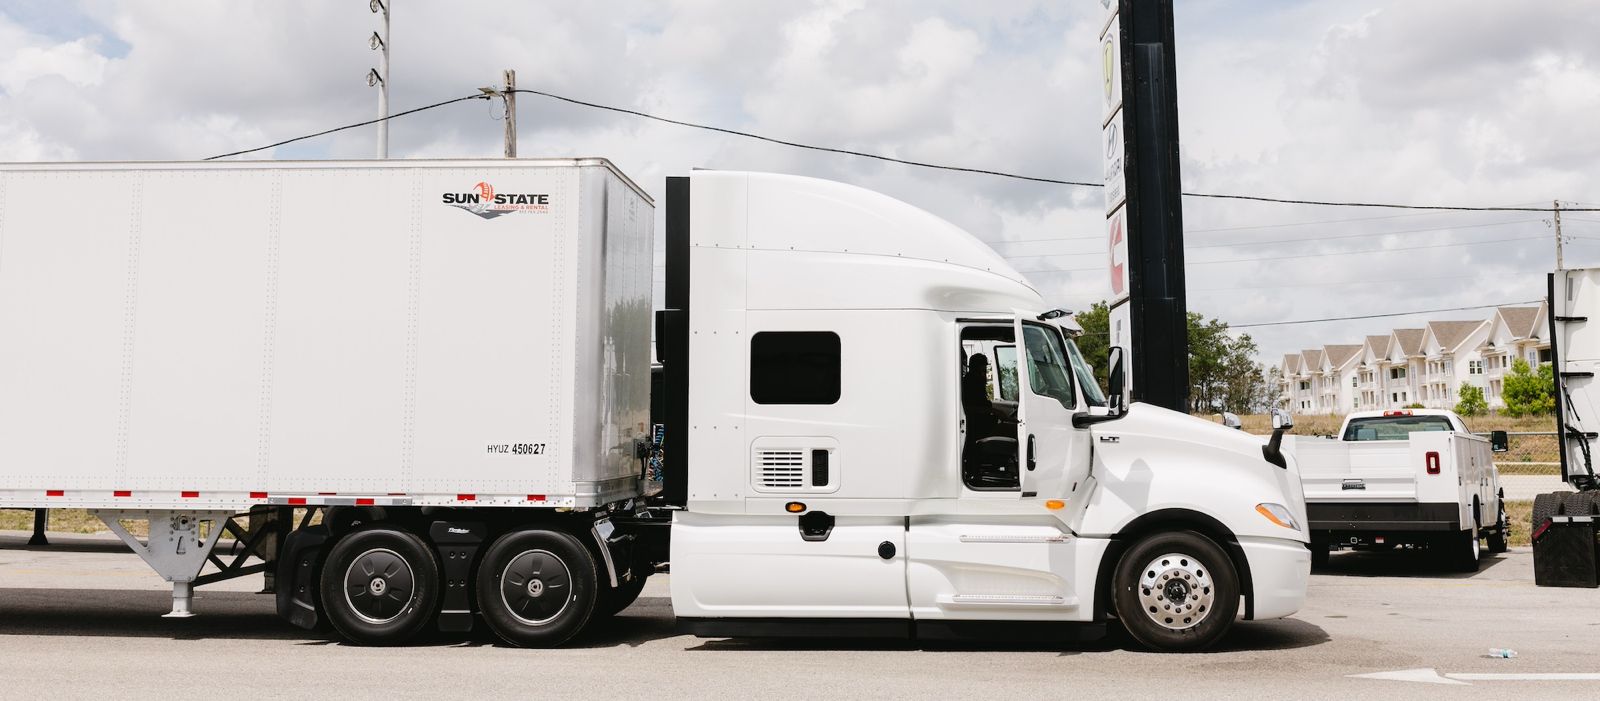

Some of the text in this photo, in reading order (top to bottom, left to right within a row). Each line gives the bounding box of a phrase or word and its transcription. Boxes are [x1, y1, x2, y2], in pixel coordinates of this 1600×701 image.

[442, 193, 549, 204] SUN STATE
[487, 443, 546, 455] HYUZ 450627
